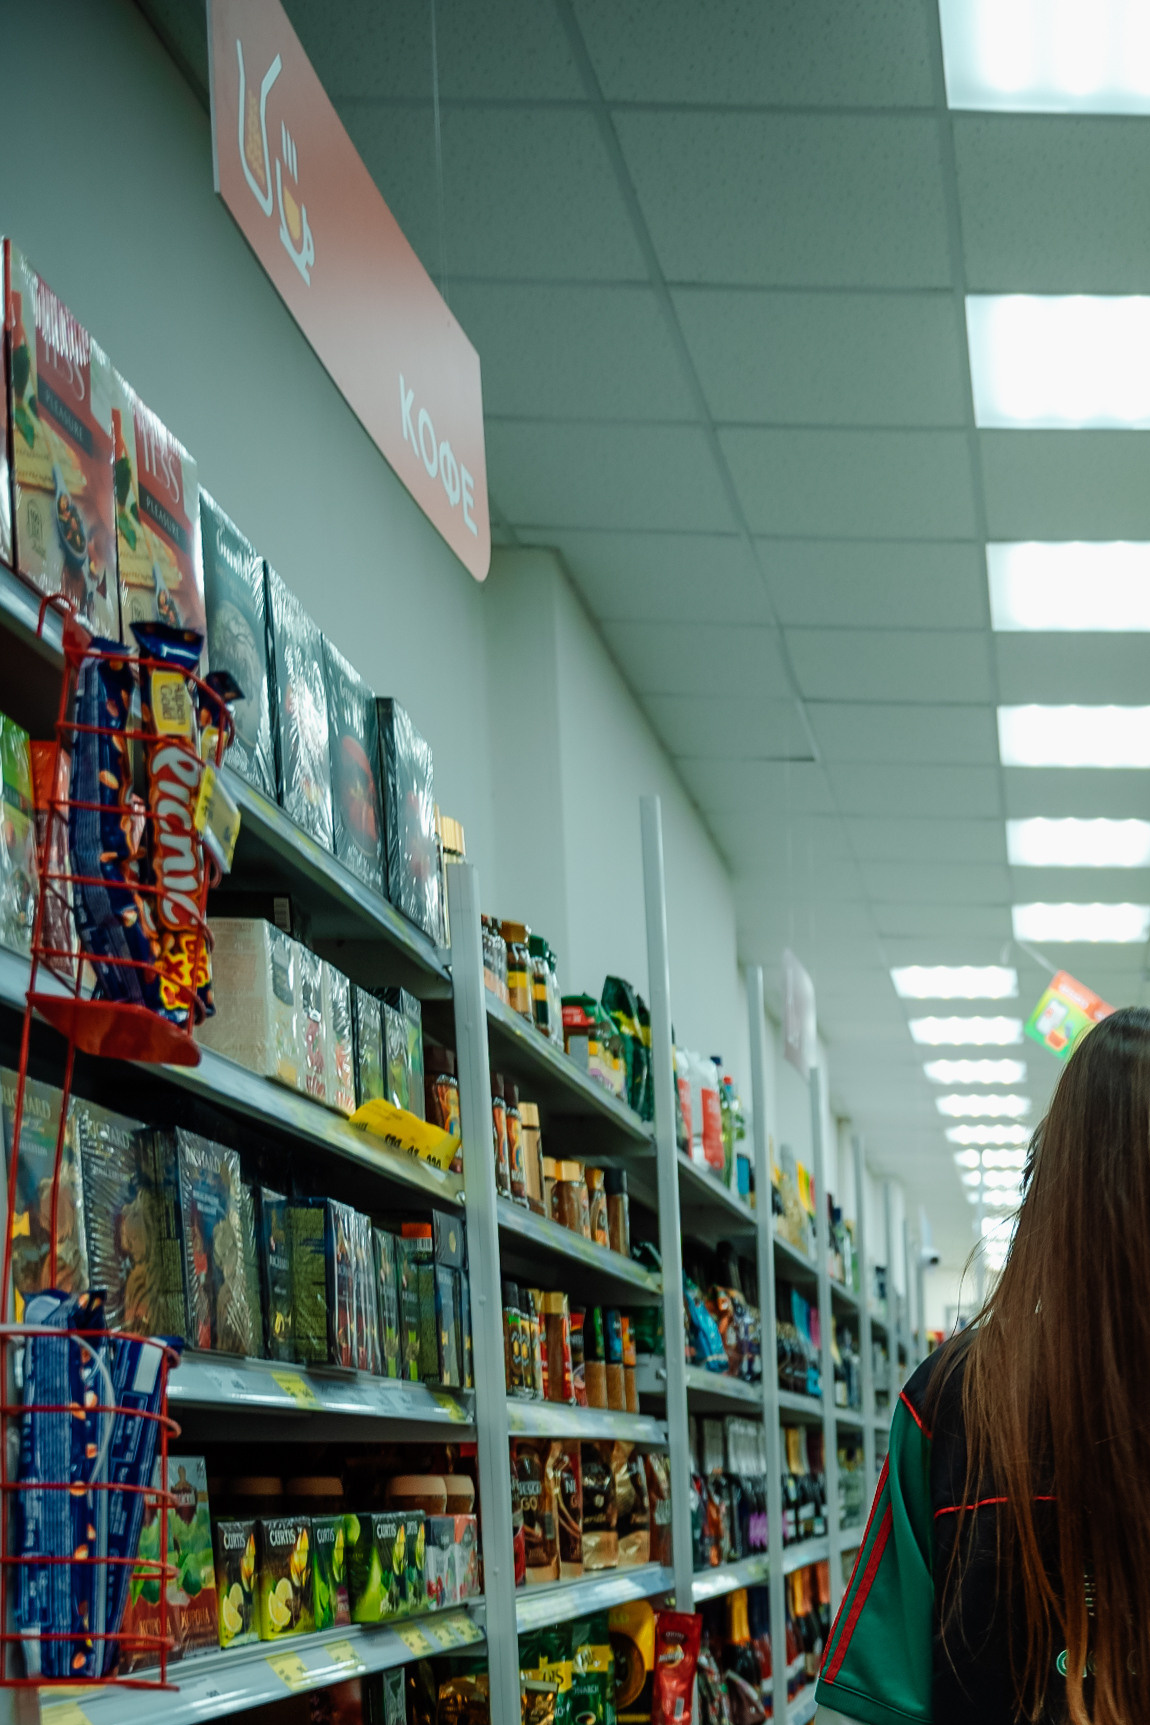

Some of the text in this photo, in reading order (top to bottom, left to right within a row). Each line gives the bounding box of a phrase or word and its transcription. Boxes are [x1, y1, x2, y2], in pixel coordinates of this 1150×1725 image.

[45, 389, 84, 443] PLEASURE
[400, 372, 478, 537] КОФЕ
[146, 497, 181, 536] PLEASURE
[269, 1527, 296, 1547] CURTIS
[316, 1528, 335, 1544] CURTIS
[376, 1522, 397, 1539] CURTIS
[223, 1532, 246, 1550] CURTIS
